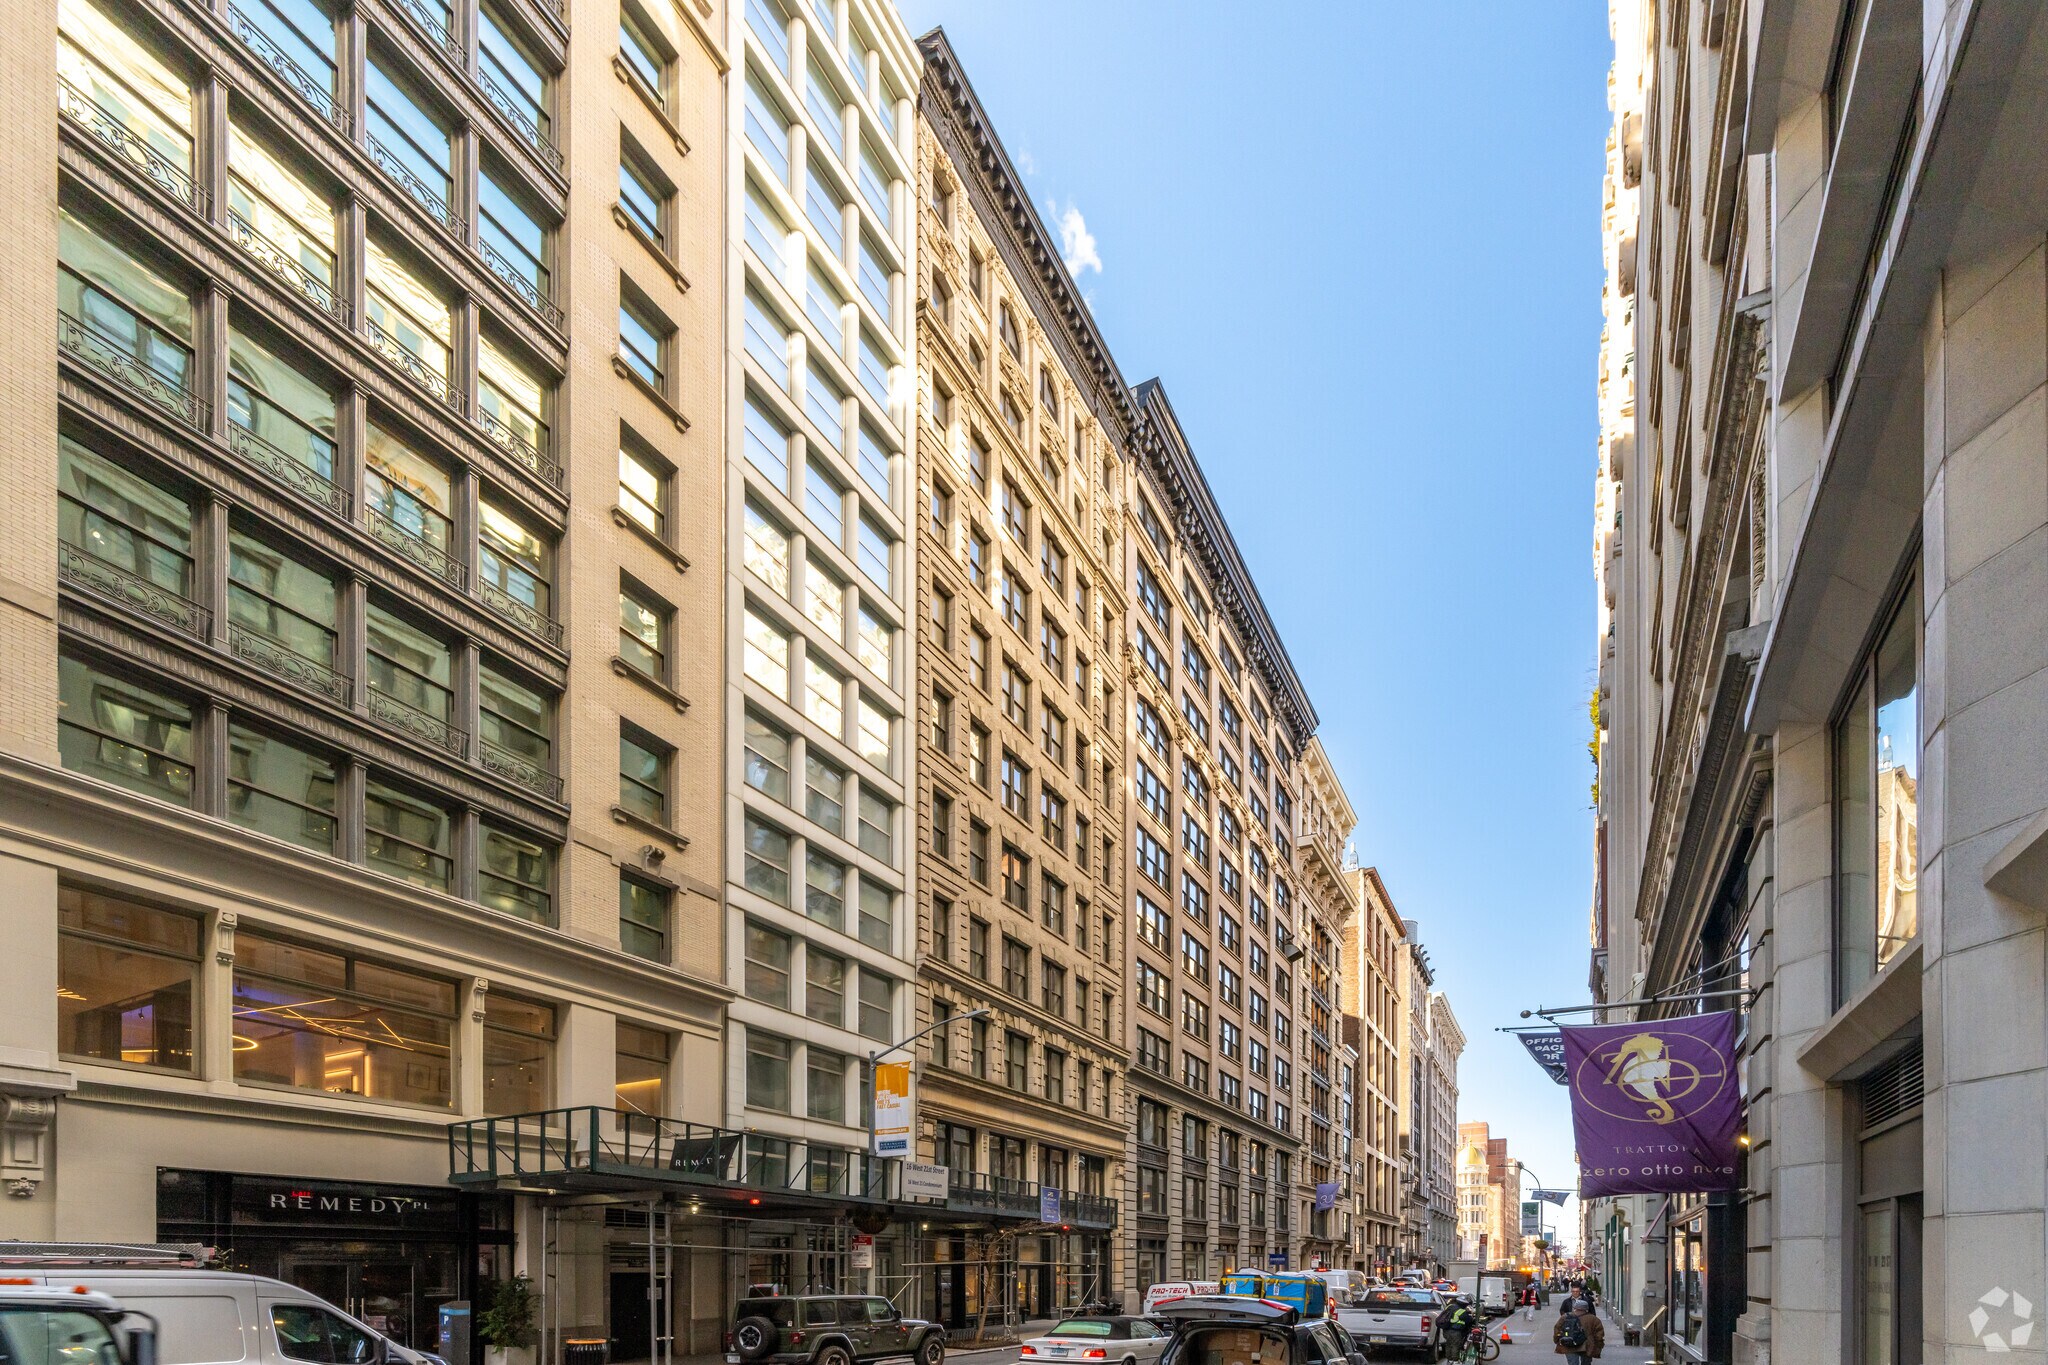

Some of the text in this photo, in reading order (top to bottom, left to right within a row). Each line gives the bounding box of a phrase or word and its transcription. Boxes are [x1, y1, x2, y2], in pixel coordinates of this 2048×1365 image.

[1525, 1037, 1563, 1046] OFFIC
[1534, 1044, 1565, 1052] PACE
[1613, 1144, 1702, 1155] TRATTOA
[912, 1163, 923, 1171] West
[932, 1166, 945, 1175] Street
[1582, 1166, 1630, 1177] zero
[1641, 1163, 1683, 1176] otto
[270, 1193, 406, 1213] REMEDY
[413, 1201, 431, 1210] PL
[443, 1315, 449, 1325] P
